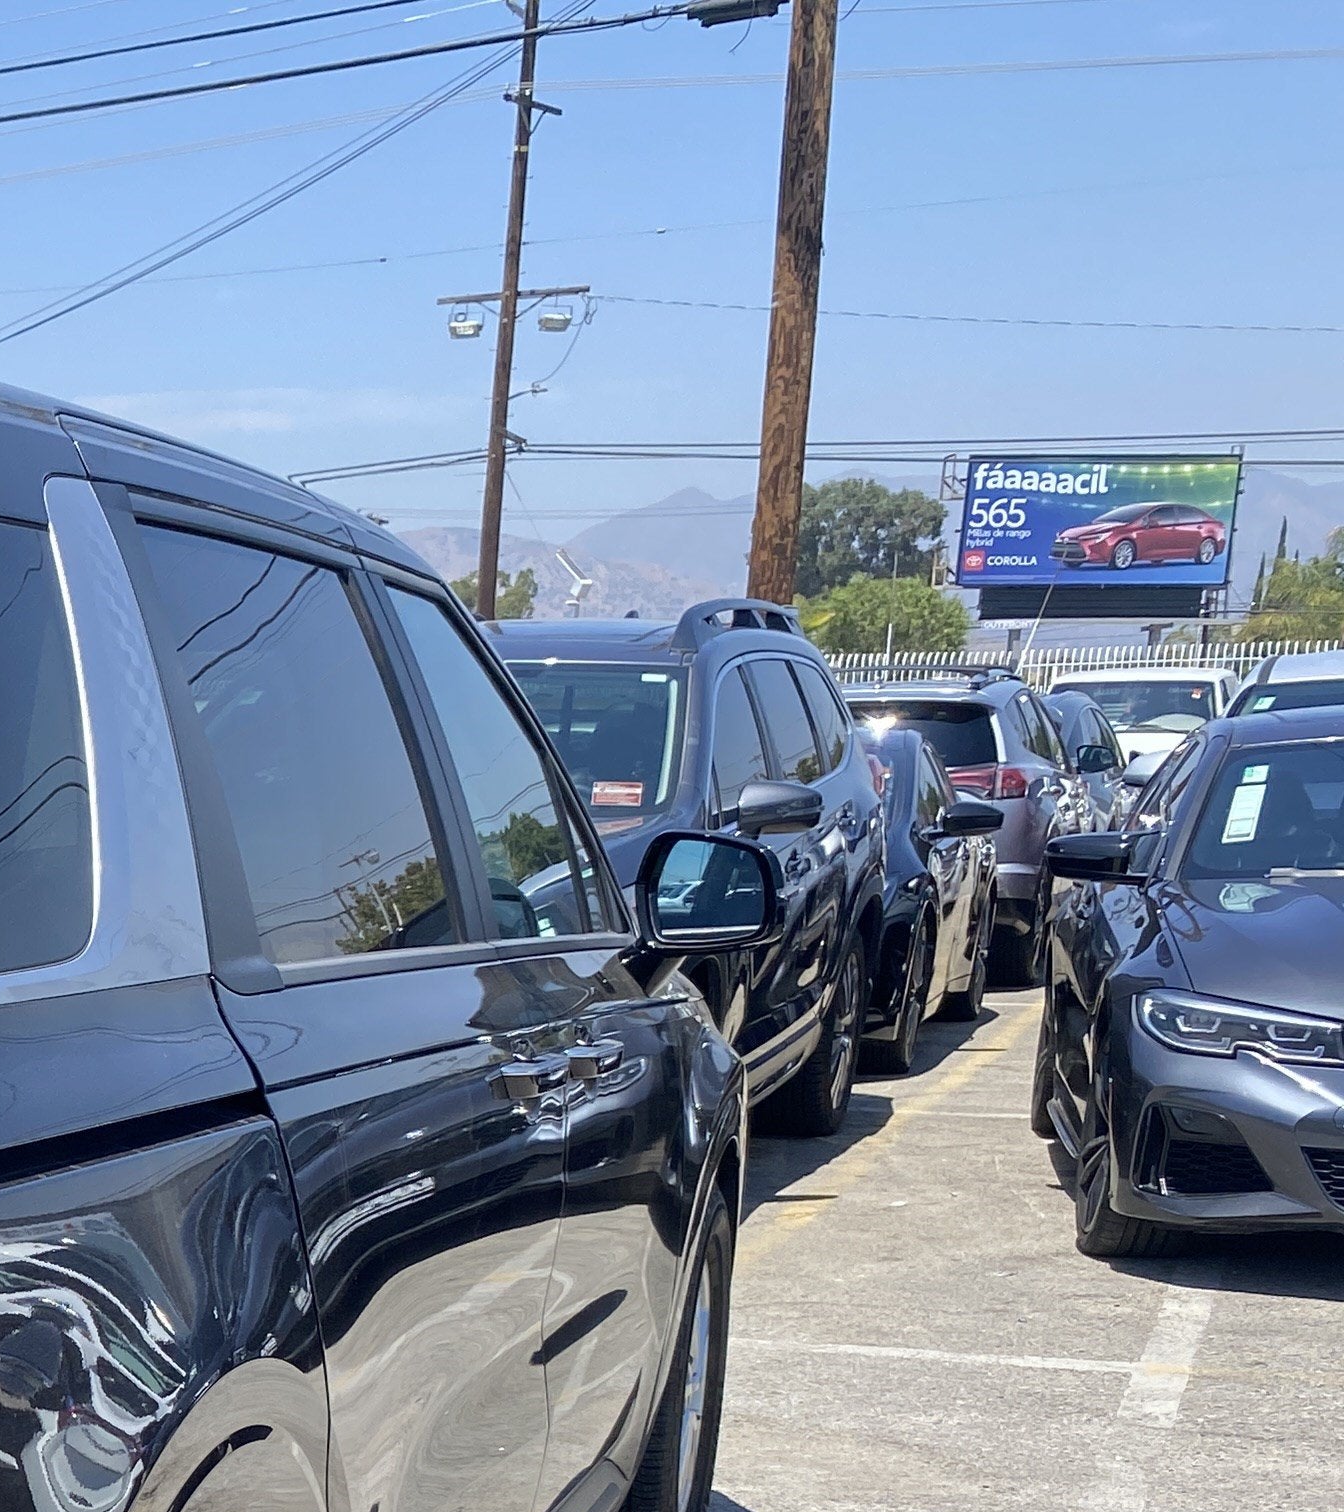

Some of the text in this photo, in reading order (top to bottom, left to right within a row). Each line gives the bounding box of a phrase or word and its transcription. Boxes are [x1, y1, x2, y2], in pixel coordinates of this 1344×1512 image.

[973, 463, 1109, 495] fáaaaacil
[968, 498, 1027, 528] 565
[992, 529, 1004, 538] de
[1005, 530, 1032, 540] rango
[965, 538, 994, 549] hybrid
[986, 556, 1038, 566] COROLLA
